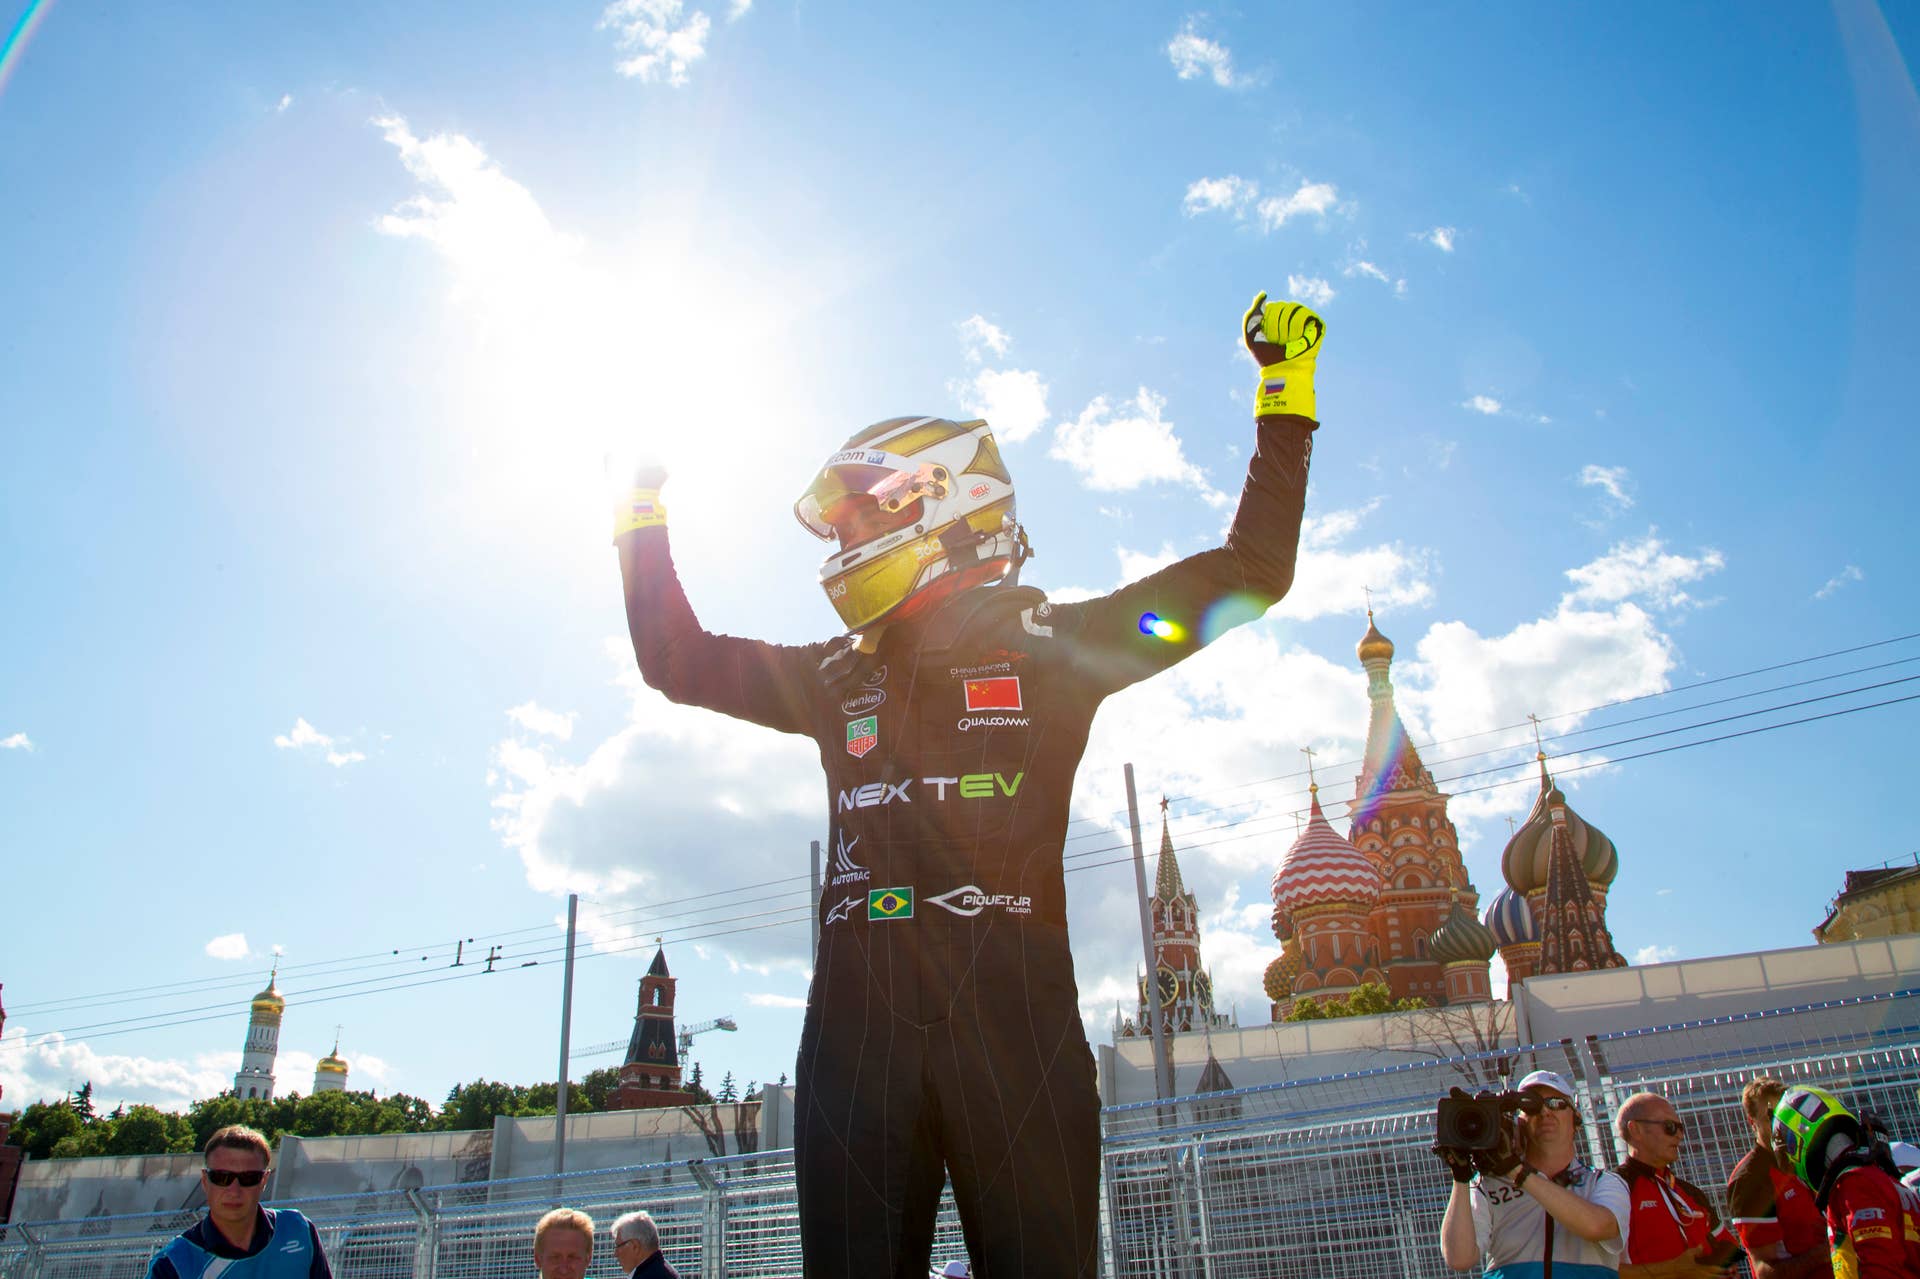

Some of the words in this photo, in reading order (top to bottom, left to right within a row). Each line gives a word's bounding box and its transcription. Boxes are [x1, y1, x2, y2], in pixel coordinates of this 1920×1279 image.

[845, 693, 882, 709] Henkel
[852, 721, 871, 737] TAG
[958, 717, 1029, 731] QUALCOMM
[848, 737, 874, 754] HEUER
[832, 871, 870, 886] AUTOTRAC
[962, 895, 1013, 907] PIQUET
[1013, 896, 1031, 907] JR
[1488, 1186, 1524, 1205] 525
[1852, 1207, 1885, 1227] ABT
